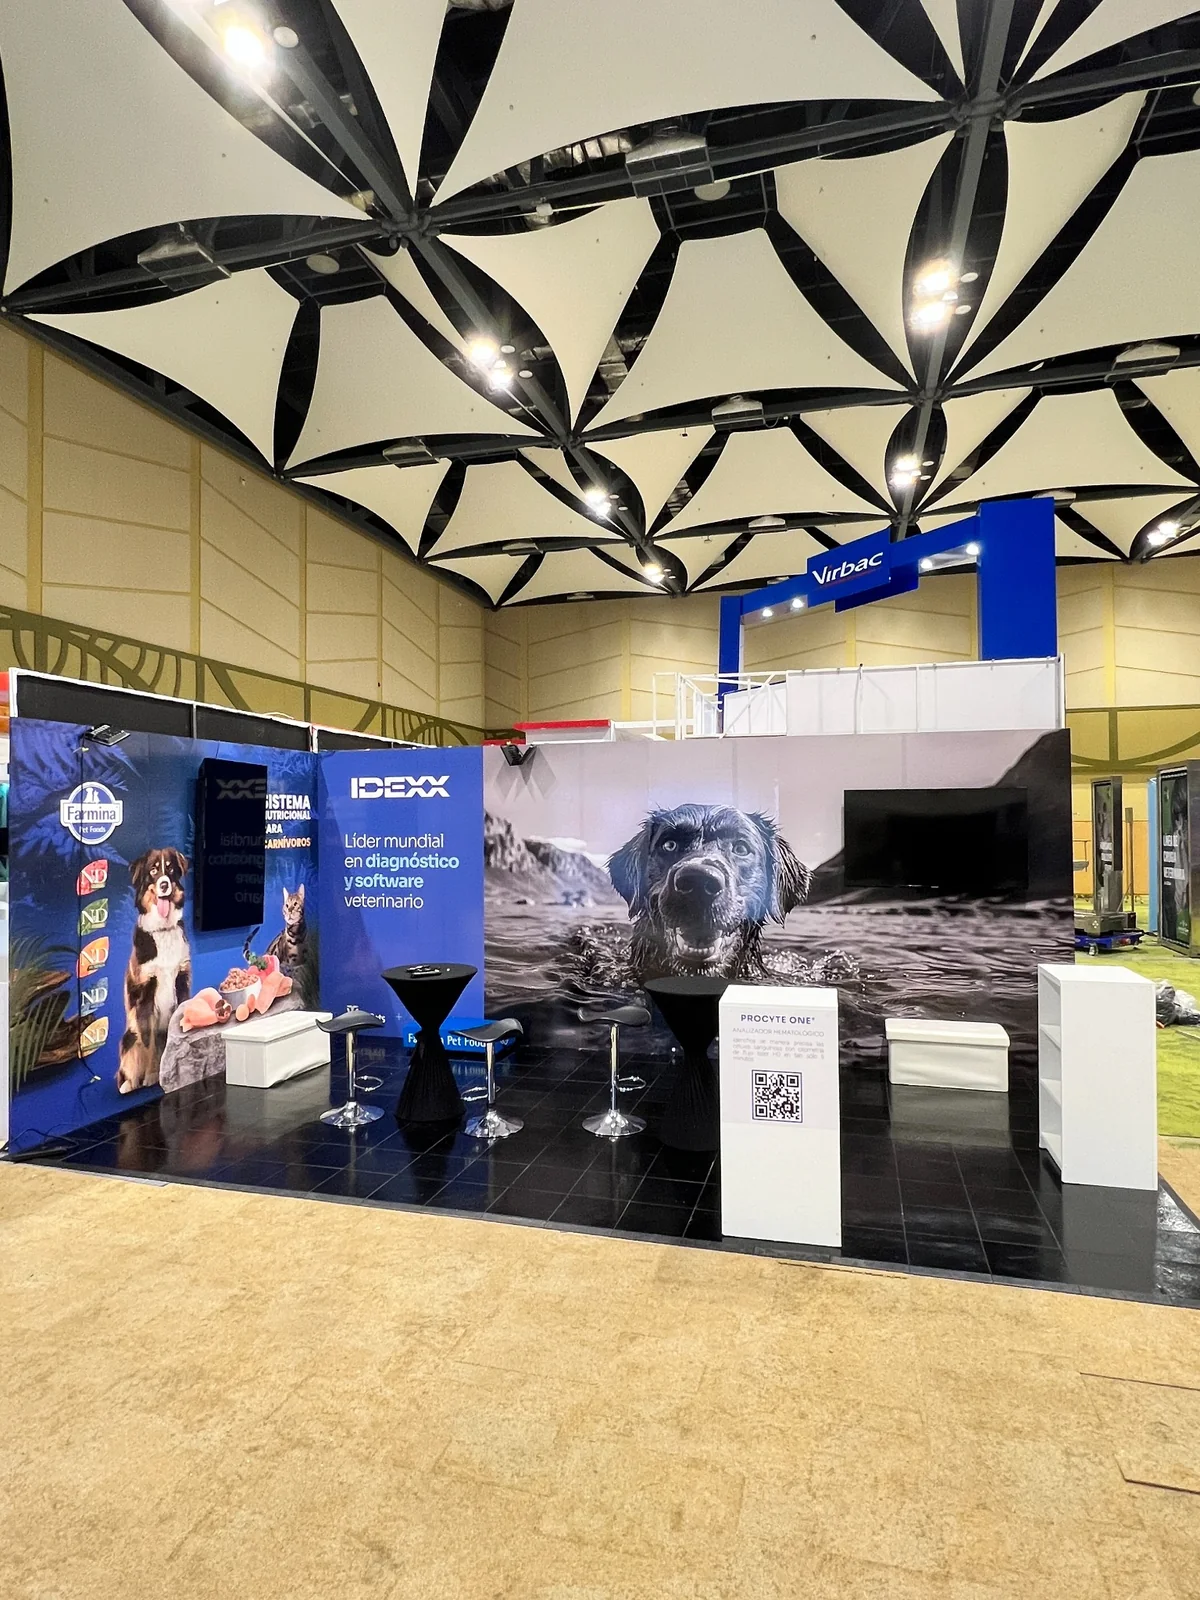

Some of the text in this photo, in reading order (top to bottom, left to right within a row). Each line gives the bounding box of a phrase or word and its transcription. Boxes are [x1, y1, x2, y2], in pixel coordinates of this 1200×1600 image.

[812, 552, 883, 584] Virbac
[351, 775, 450, 799] IDEXX
[67, 806, 116, 820] Farmina
[265, 823, 283, 834] ARA
[345, 832, 444, 848] Líder mundial
[344, 852, 460, 872] en diagnóstico
[344, 873, 424, 891] y software
[344, 893, 424, 909] veterinario
[740, 1014, 787, 1024] PROCYTE
[732, 1027, 772, 1035] ANALIZADOR
[447, 1035, 462, 1046] Pet
